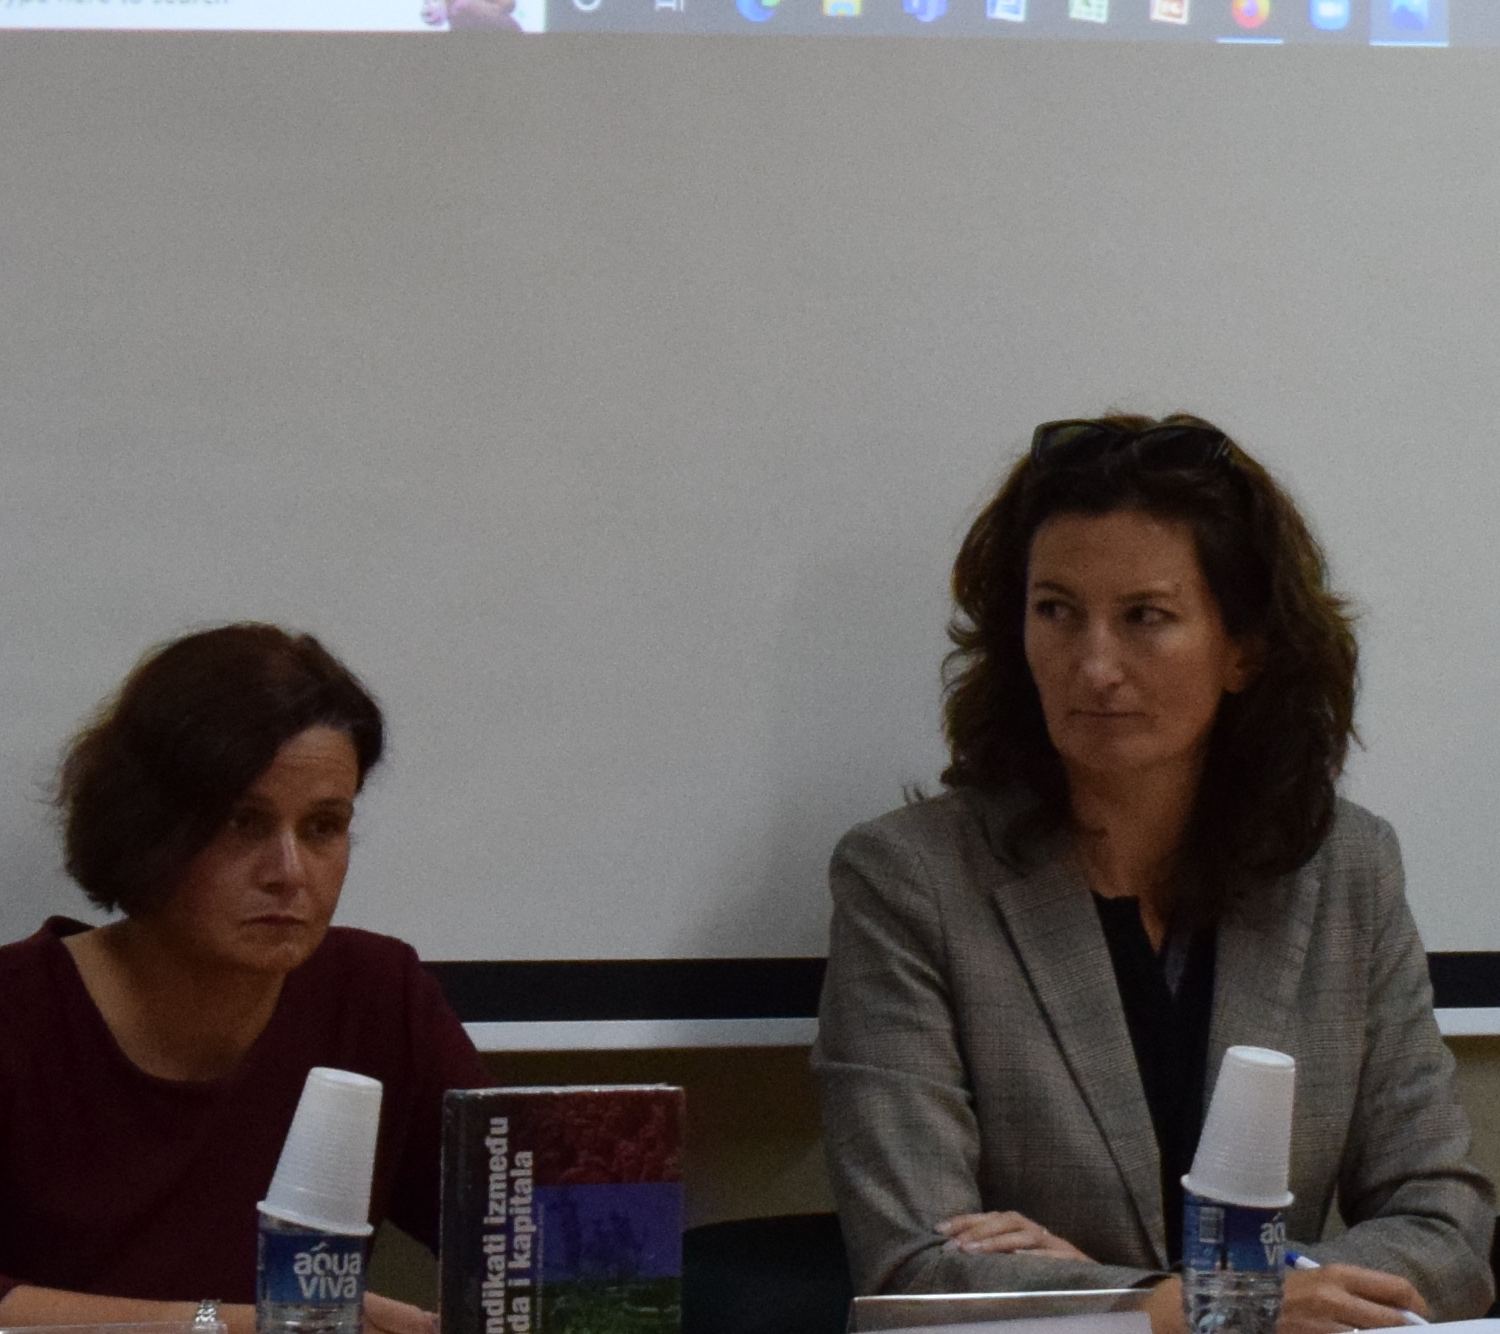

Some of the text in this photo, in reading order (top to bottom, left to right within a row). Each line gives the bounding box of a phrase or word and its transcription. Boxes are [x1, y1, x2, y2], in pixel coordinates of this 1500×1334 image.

[482, 1114, 510, 1227] između
[508, 1148, 537, 1271] kapitala
[299, 1275, 358, 1300] viva
